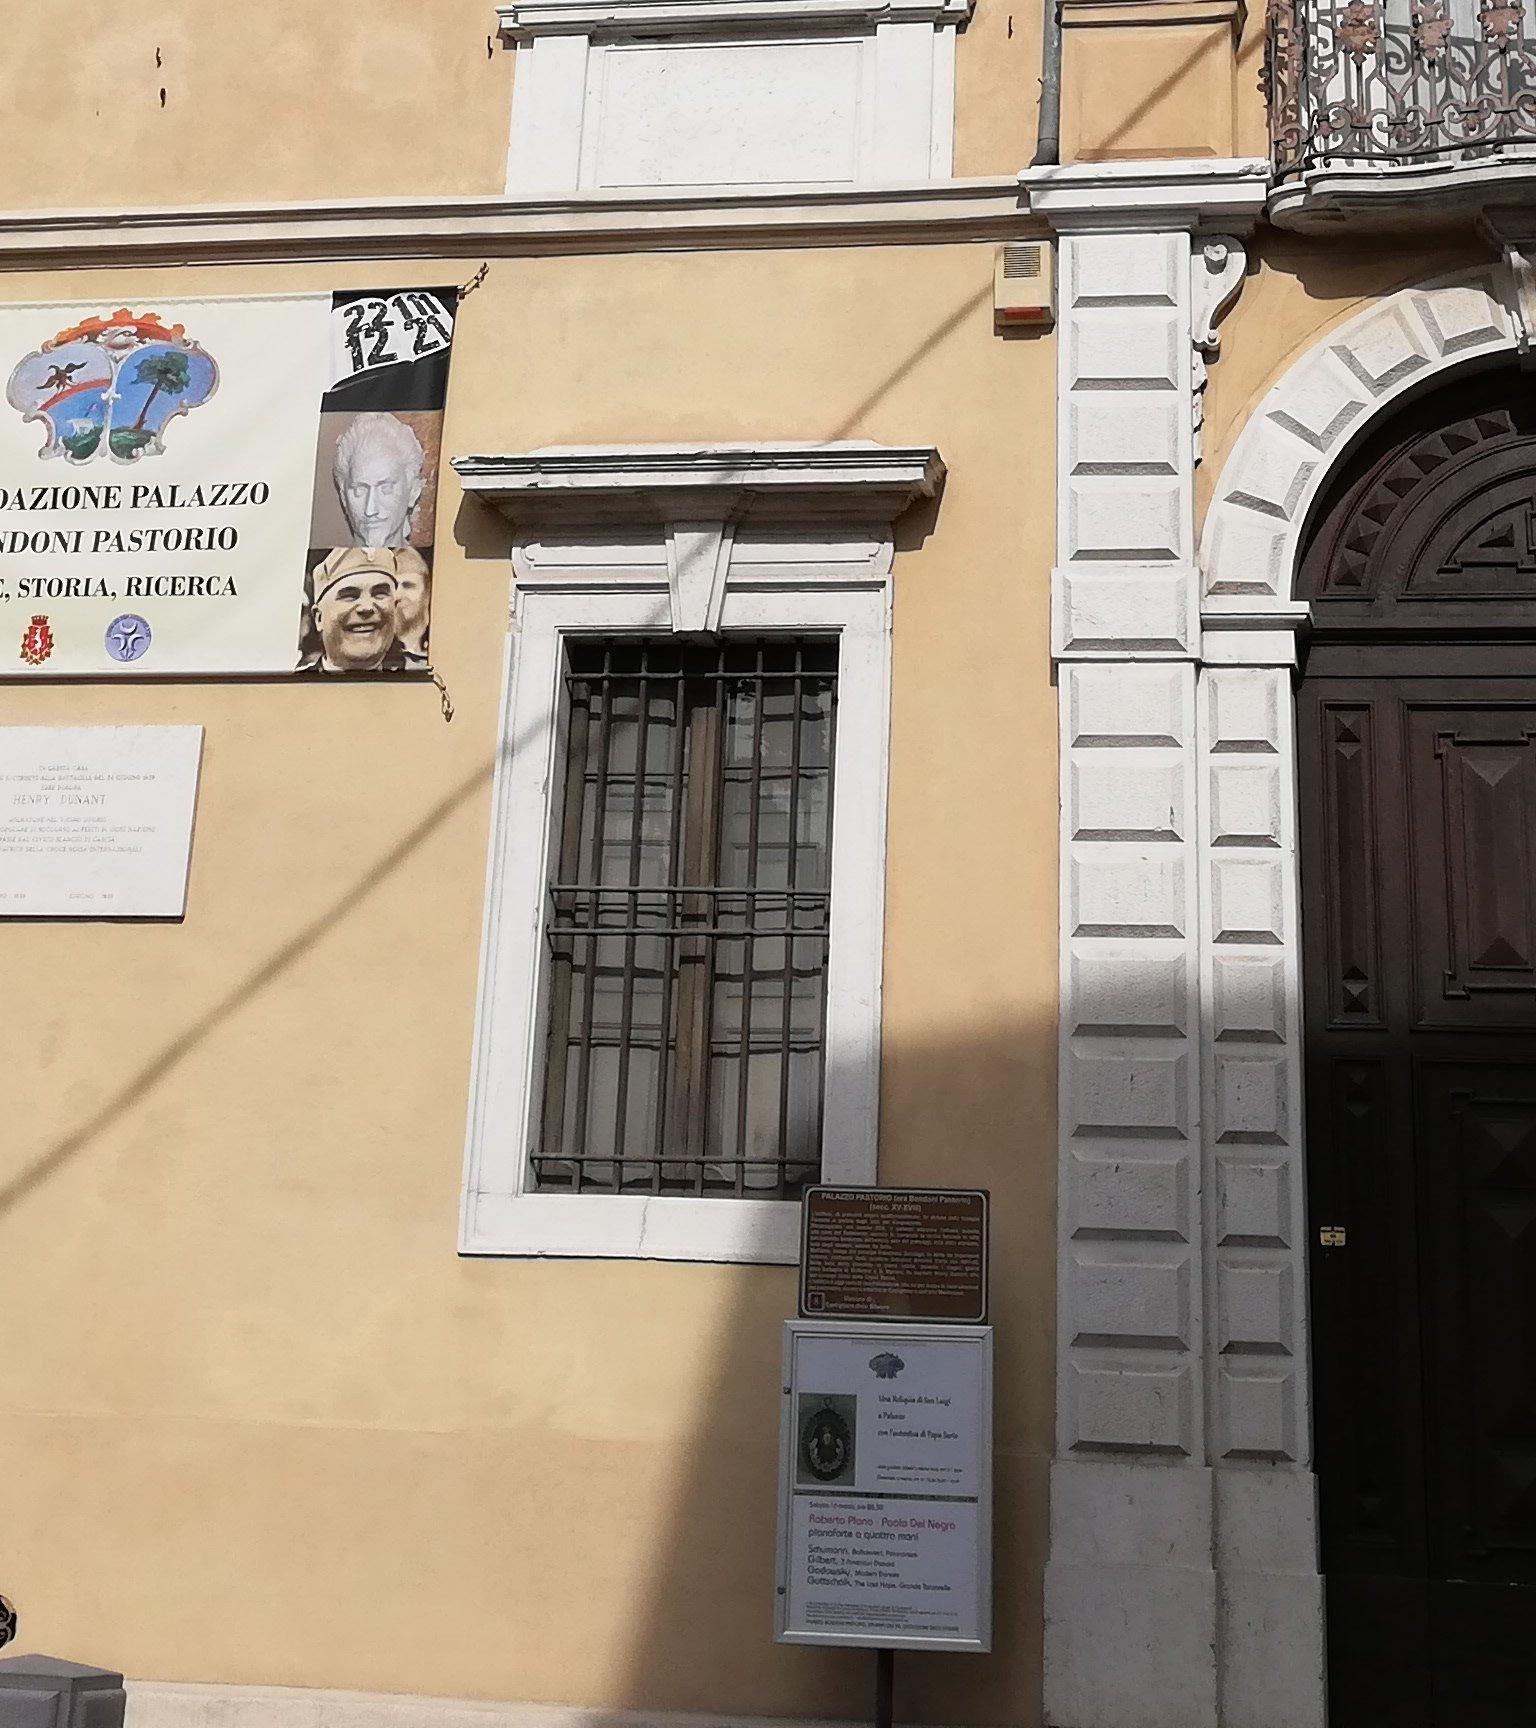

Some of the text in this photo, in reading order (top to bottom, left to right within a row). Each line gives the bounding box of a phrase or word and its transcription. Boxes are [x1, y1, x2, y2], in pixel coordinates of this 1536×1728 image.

[130, 481, 269, 509] PALAZZO
[91, 526, 238, 552] PASTORIO
[18, 576, 117, 601] STORIA,
[124, 575, 238, 597] RICERCA
[12, 793, 106, 805] HENRY DUNANT
[821, 1192, 855, 1201] PALAZZO
[855, 1193, 893, 1202] PASTORIO
[808, 1514, 846, 1525] Roberto
[881, 1516, 908, 1528] Paola
[909, 1518, 926, 1529] Del
[927, 1519, 956, 1532] Negro
[808, 1528, 919, 1541] pianoforte a quattro mani
